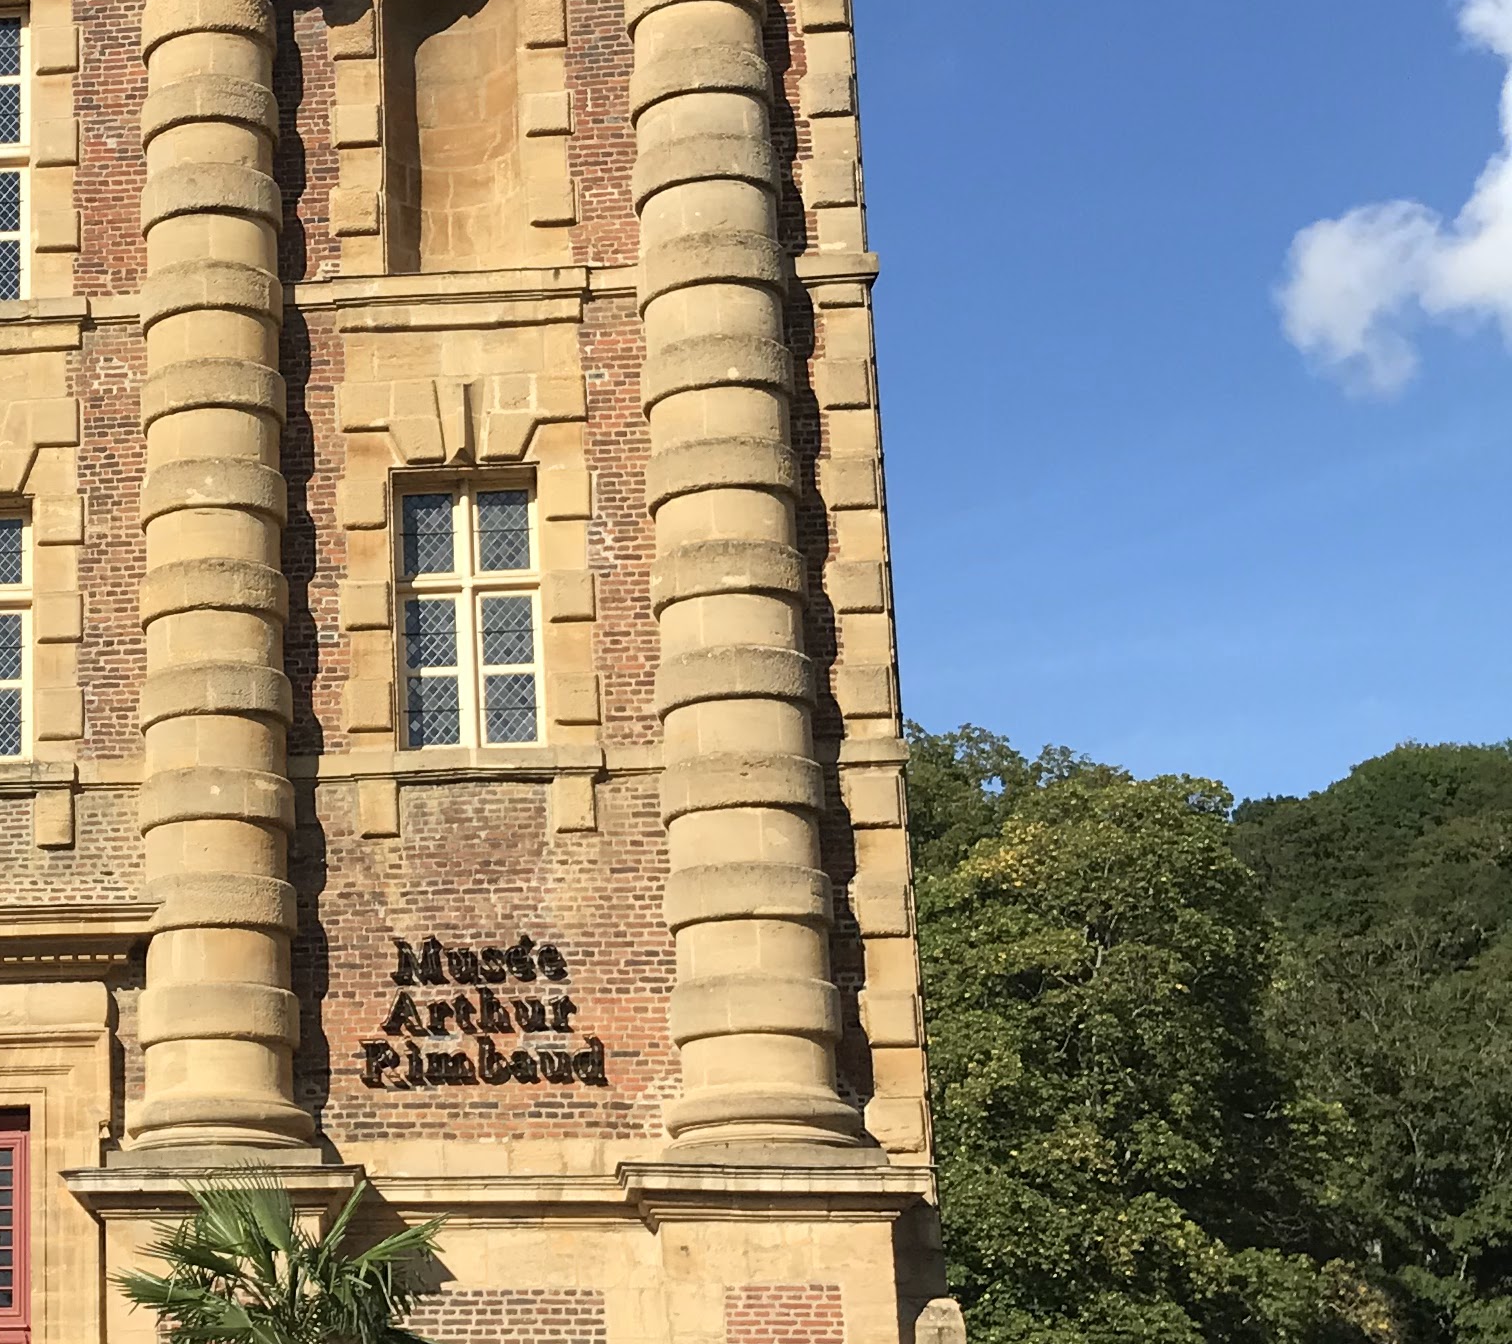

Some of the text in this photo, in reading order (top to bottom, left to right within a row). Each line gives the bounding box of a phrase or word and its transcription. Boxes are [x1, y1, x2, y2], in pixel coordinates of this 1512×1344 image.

[391, 935, 567, 985] Musée
[380, 986, 577, 1036] Arthur
[358, 1034, 609, 1089] Rimbaud
